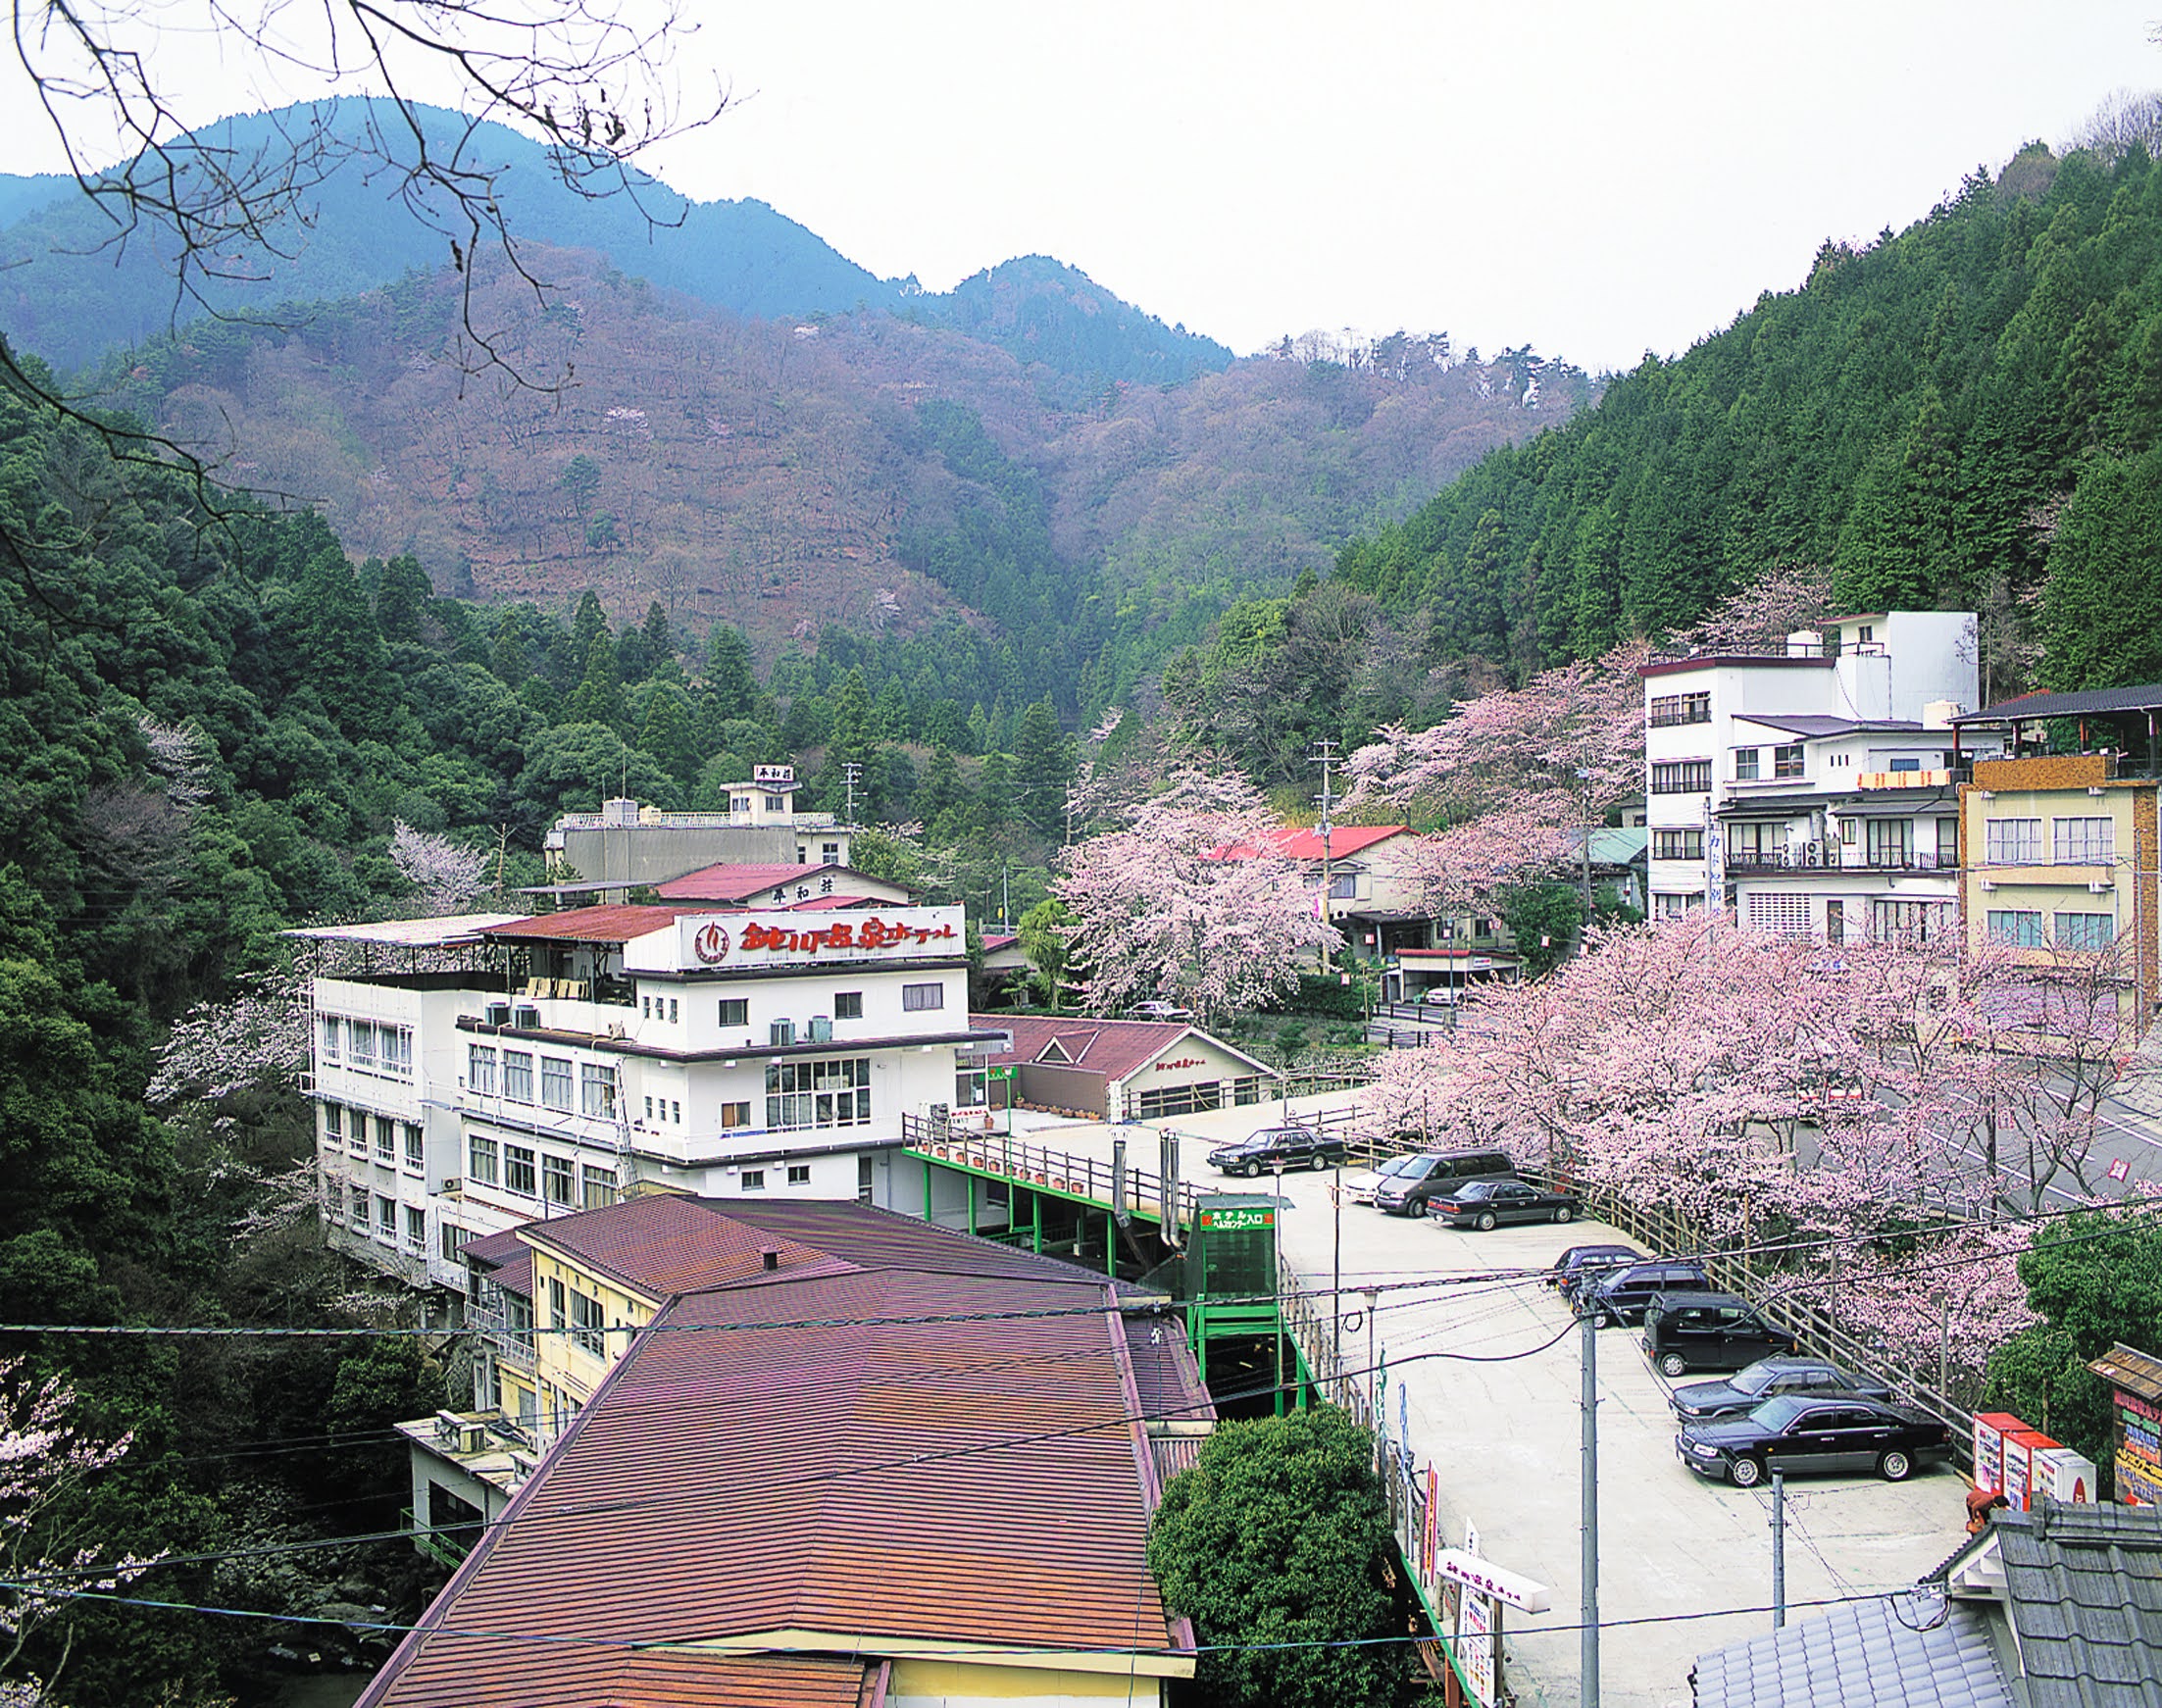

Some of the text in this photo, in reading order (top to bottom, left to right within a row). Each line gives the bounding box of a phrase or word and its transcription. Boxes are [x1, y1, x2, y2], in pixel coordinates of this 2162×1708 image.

[759, 768, 791, 779] 平和荘
[773, 879, 833, 905] 平和荘
[740, 917, 958, 954] 鈍川温泉ホテル
[1212, 1211, 1246, 1220] ホテル
[1245, 1214, 1263, 1225] 入口
